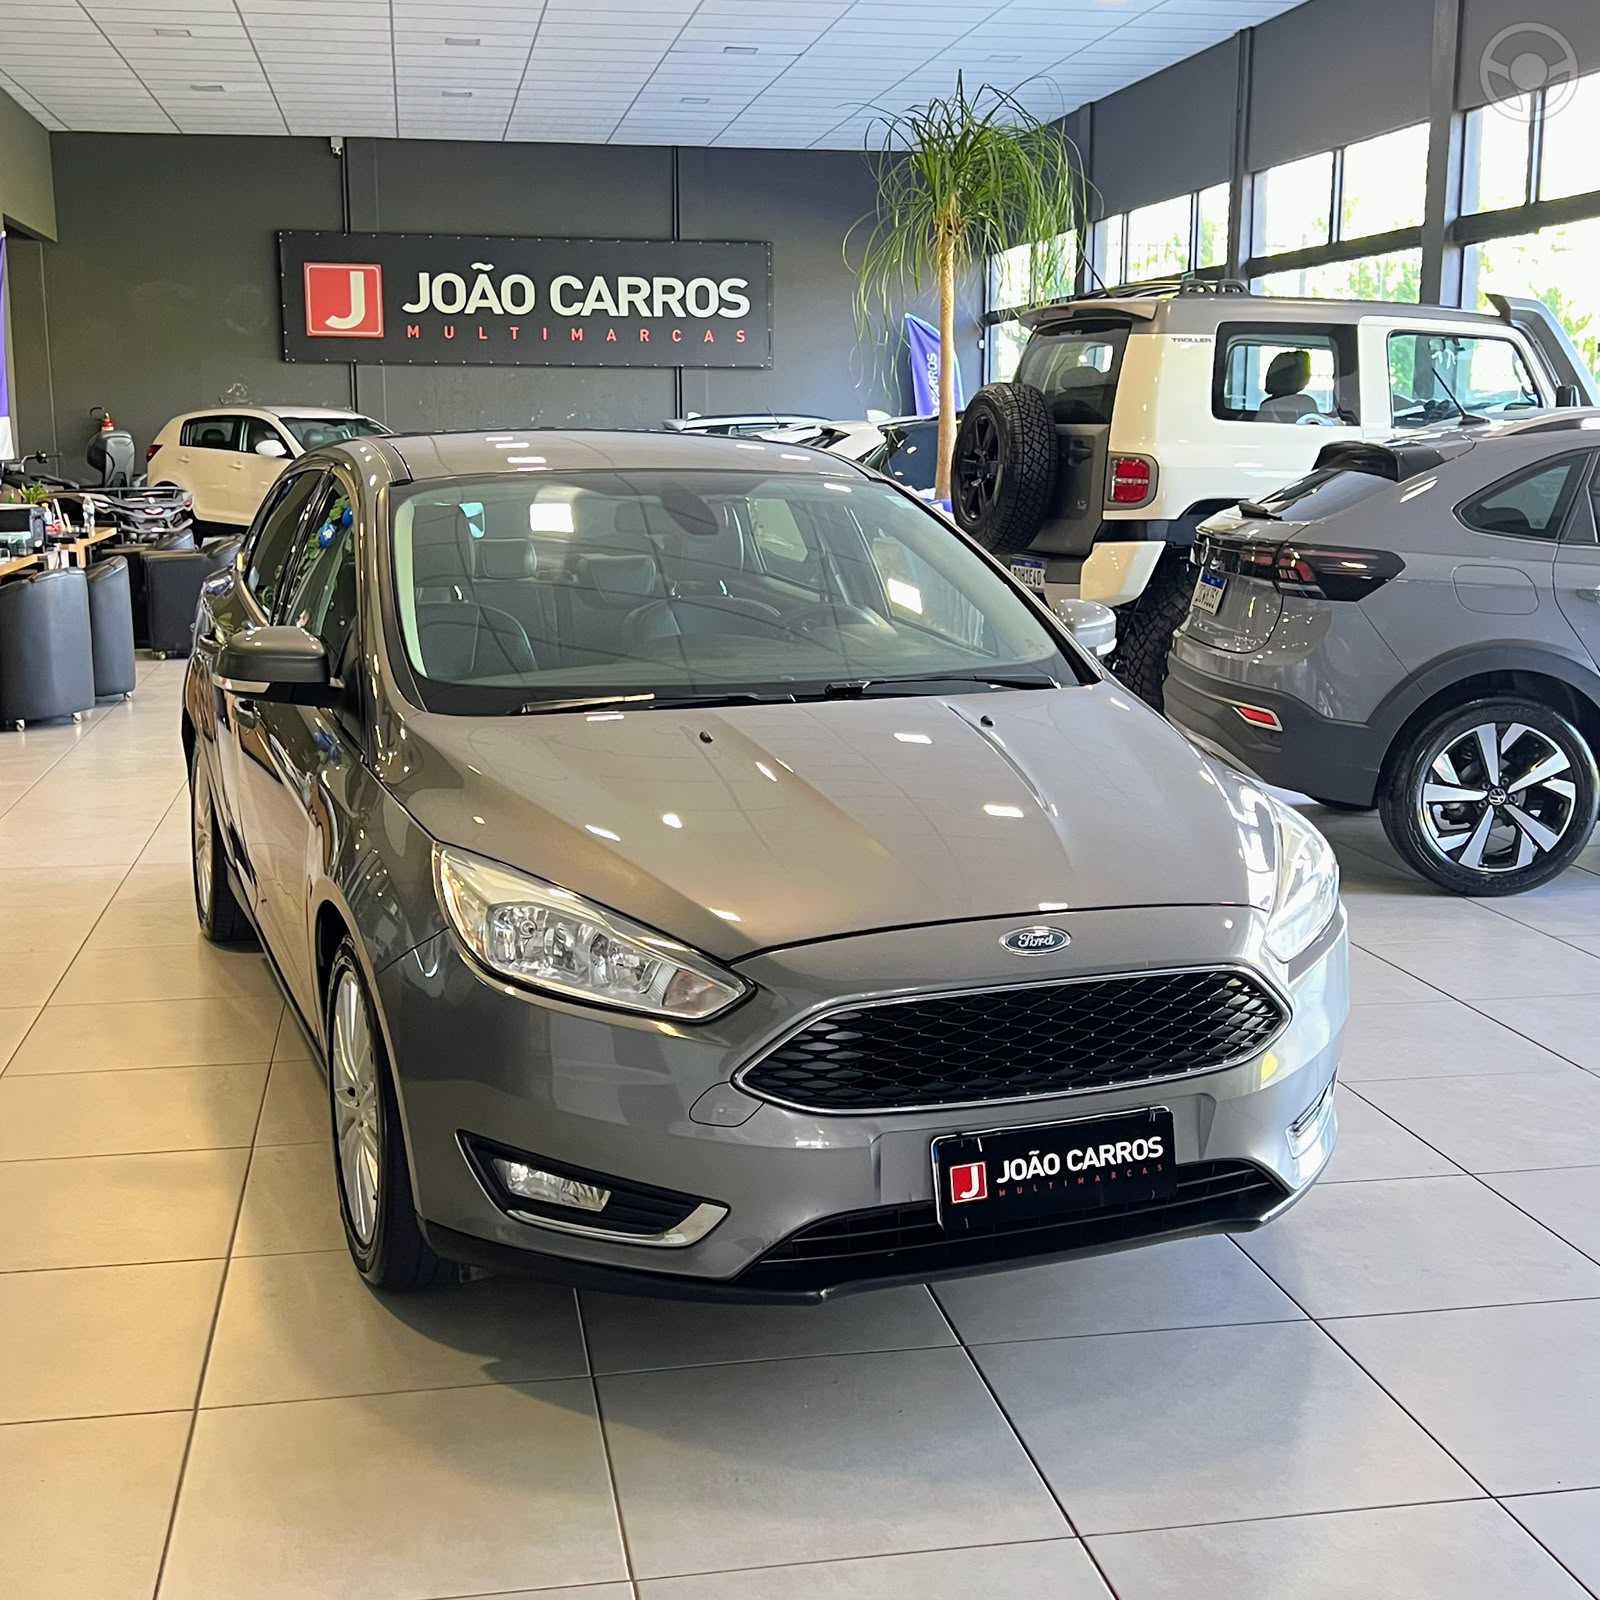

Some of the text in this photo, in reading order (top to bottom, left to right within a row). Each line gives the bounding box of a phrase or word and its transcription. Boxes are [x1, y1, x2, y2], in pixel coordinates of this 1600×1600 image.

[401, 262, 751, 319] JOÃO CARROS
[406, 324, 747, 344] MULTIMARCAS
[1017, 932, 1055, 947] Ford
[996, 1136, 1164, 1184] JOÃO CARROS
[998, 1163, 1163, 1197] MULTIMARCAS
